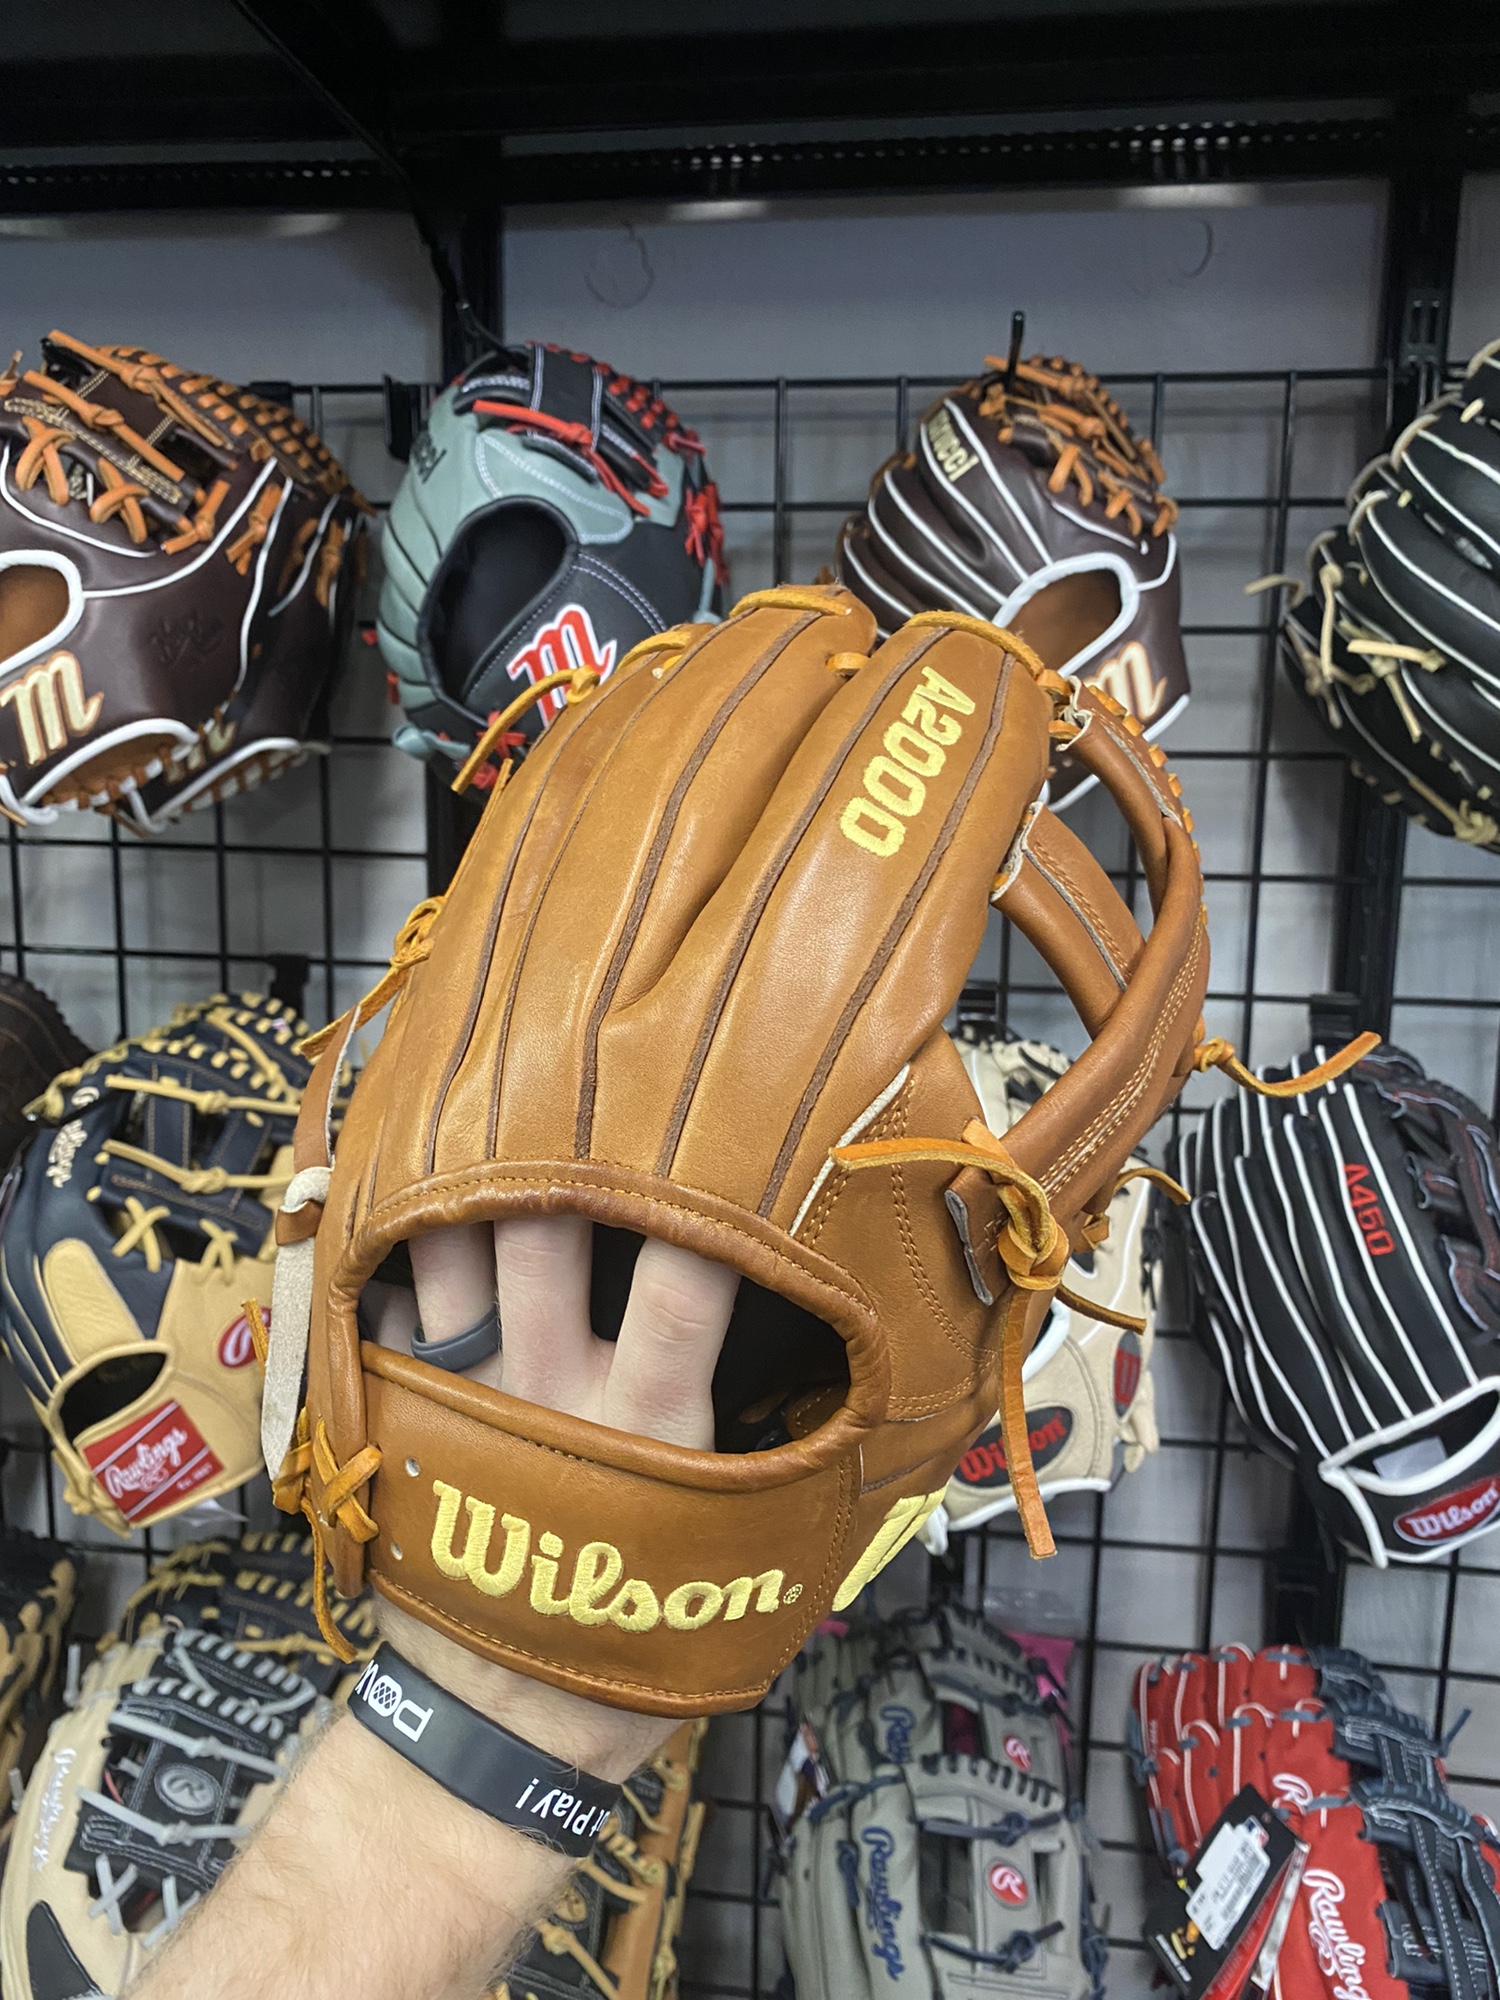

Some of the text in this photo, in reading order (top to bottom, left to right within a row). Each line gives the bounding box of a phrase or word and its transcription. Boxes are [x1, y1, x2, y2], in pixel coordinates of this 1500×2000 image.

[840, 667, 976, 858] A2000
[104, 1426, 189, 1498] Rawlings
[1405, 1486, 1499, 1538] Wilson
[430, 1479, 785, 1632] Wilson
